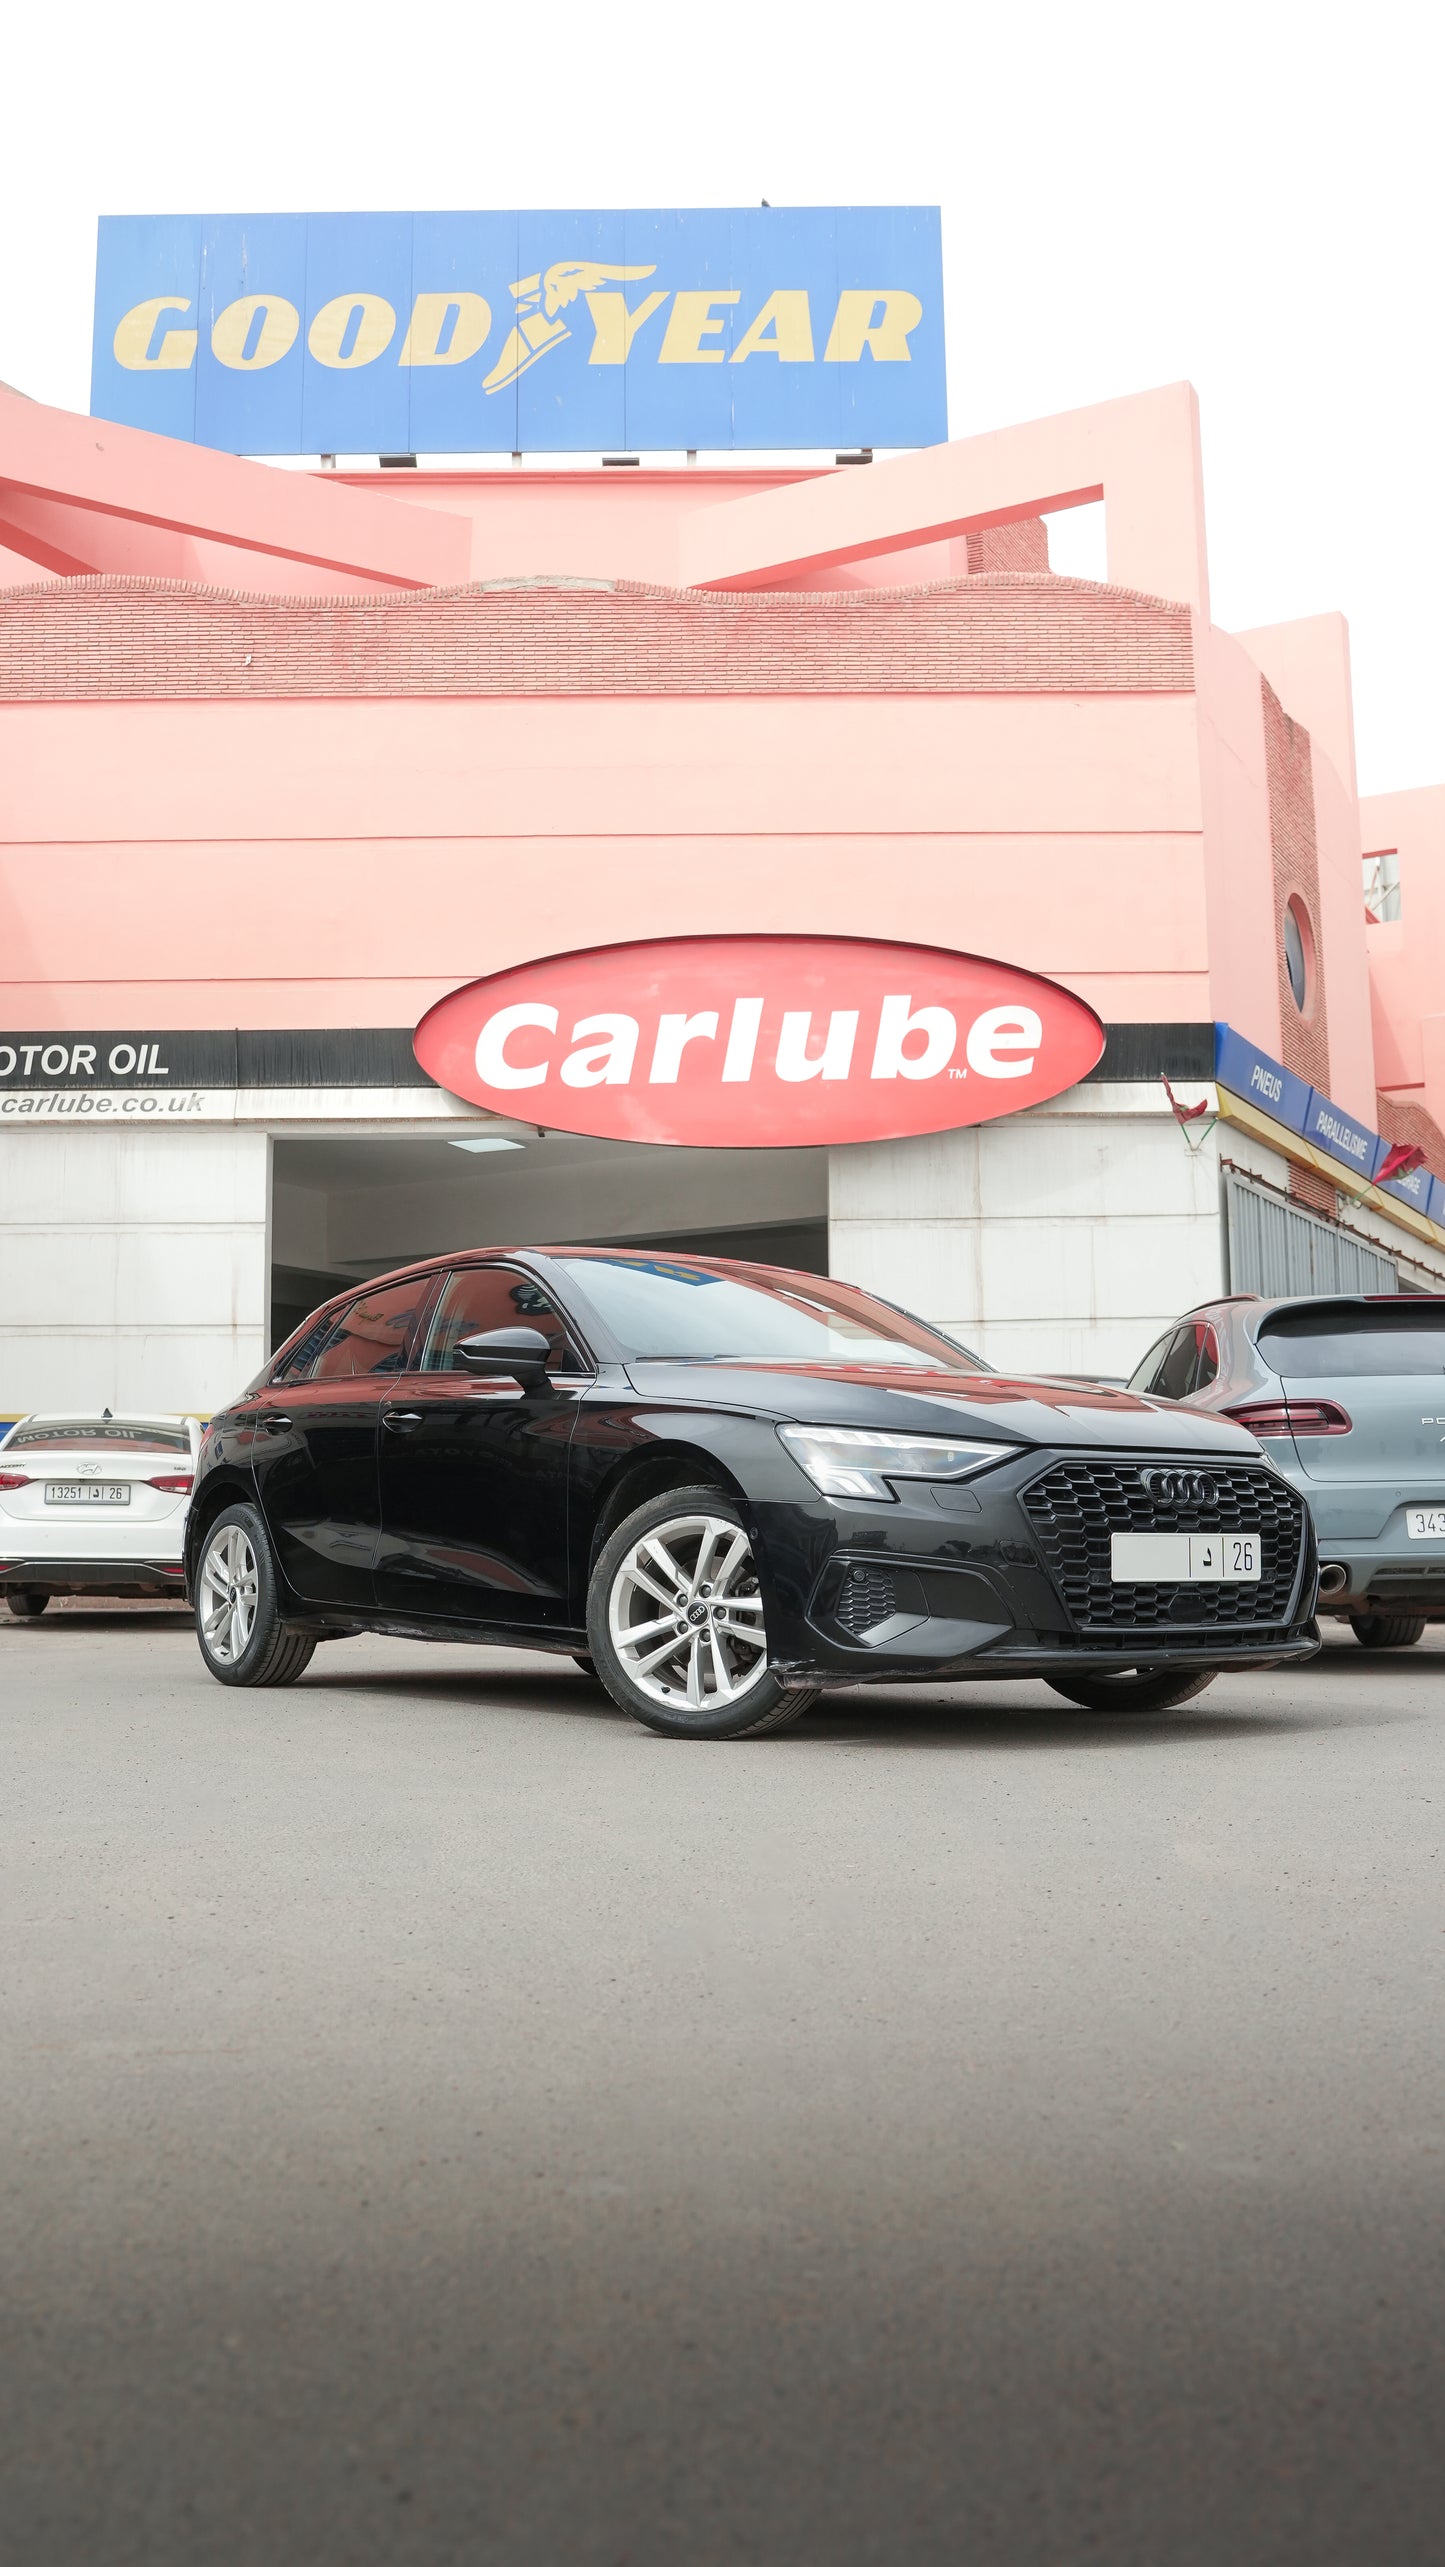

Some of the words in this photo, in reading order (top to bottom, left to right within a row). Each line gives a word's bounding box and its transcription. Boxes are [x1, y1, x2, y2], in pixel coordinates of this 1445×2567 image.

[475, 995, 1043, 1090] Carlube
[108, 1043, 169, 1075] OIL
[1250, 1064, 1283, 1103] PNEUS
[1, 1092, 206, 1114] carlube.co.uk
[52, 1486, 82, 1499] 13251
[109, 1487, 122, 1500] 26
[1233, 1542, 1253, 1571] 26
